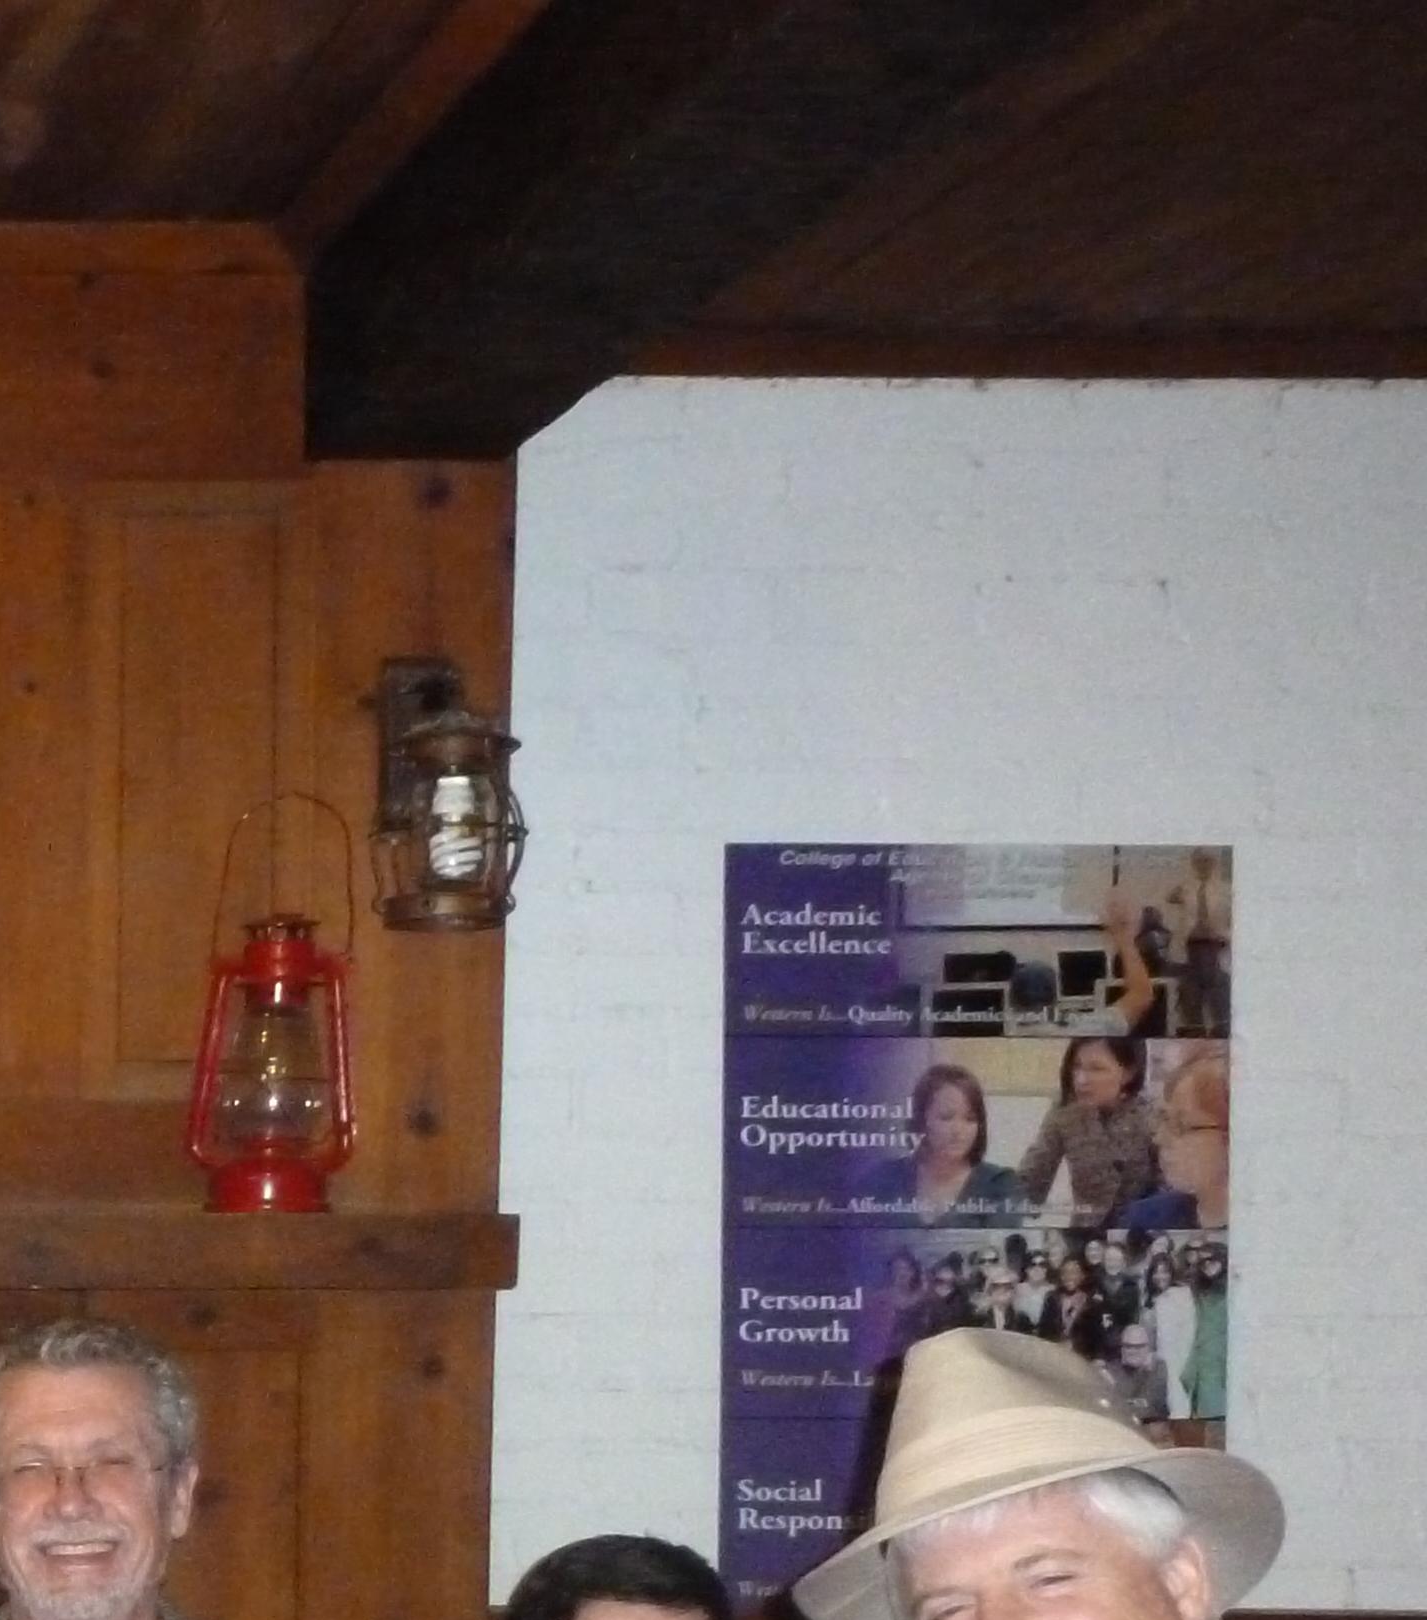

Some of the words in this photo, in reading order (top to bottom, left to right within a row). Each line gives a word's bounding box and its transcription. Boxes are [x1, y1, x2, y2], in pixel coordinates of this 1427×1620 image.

[779, 849, 856, 870] College
[862, 852, 883, 866] of
[740, 902, 883, 927] Academic
[741, 931, 892, 955] Excellence
[744, 1004, 814, 1022] Western
[740, 1095, 913, 1119] Educational
[740, 1123, 926, 1155] Opportunity
[739, 1286, 863, 1311] Personal
[739, 1319, 851, 1343] Growth
[737, 1478, 823, 1502] Social
